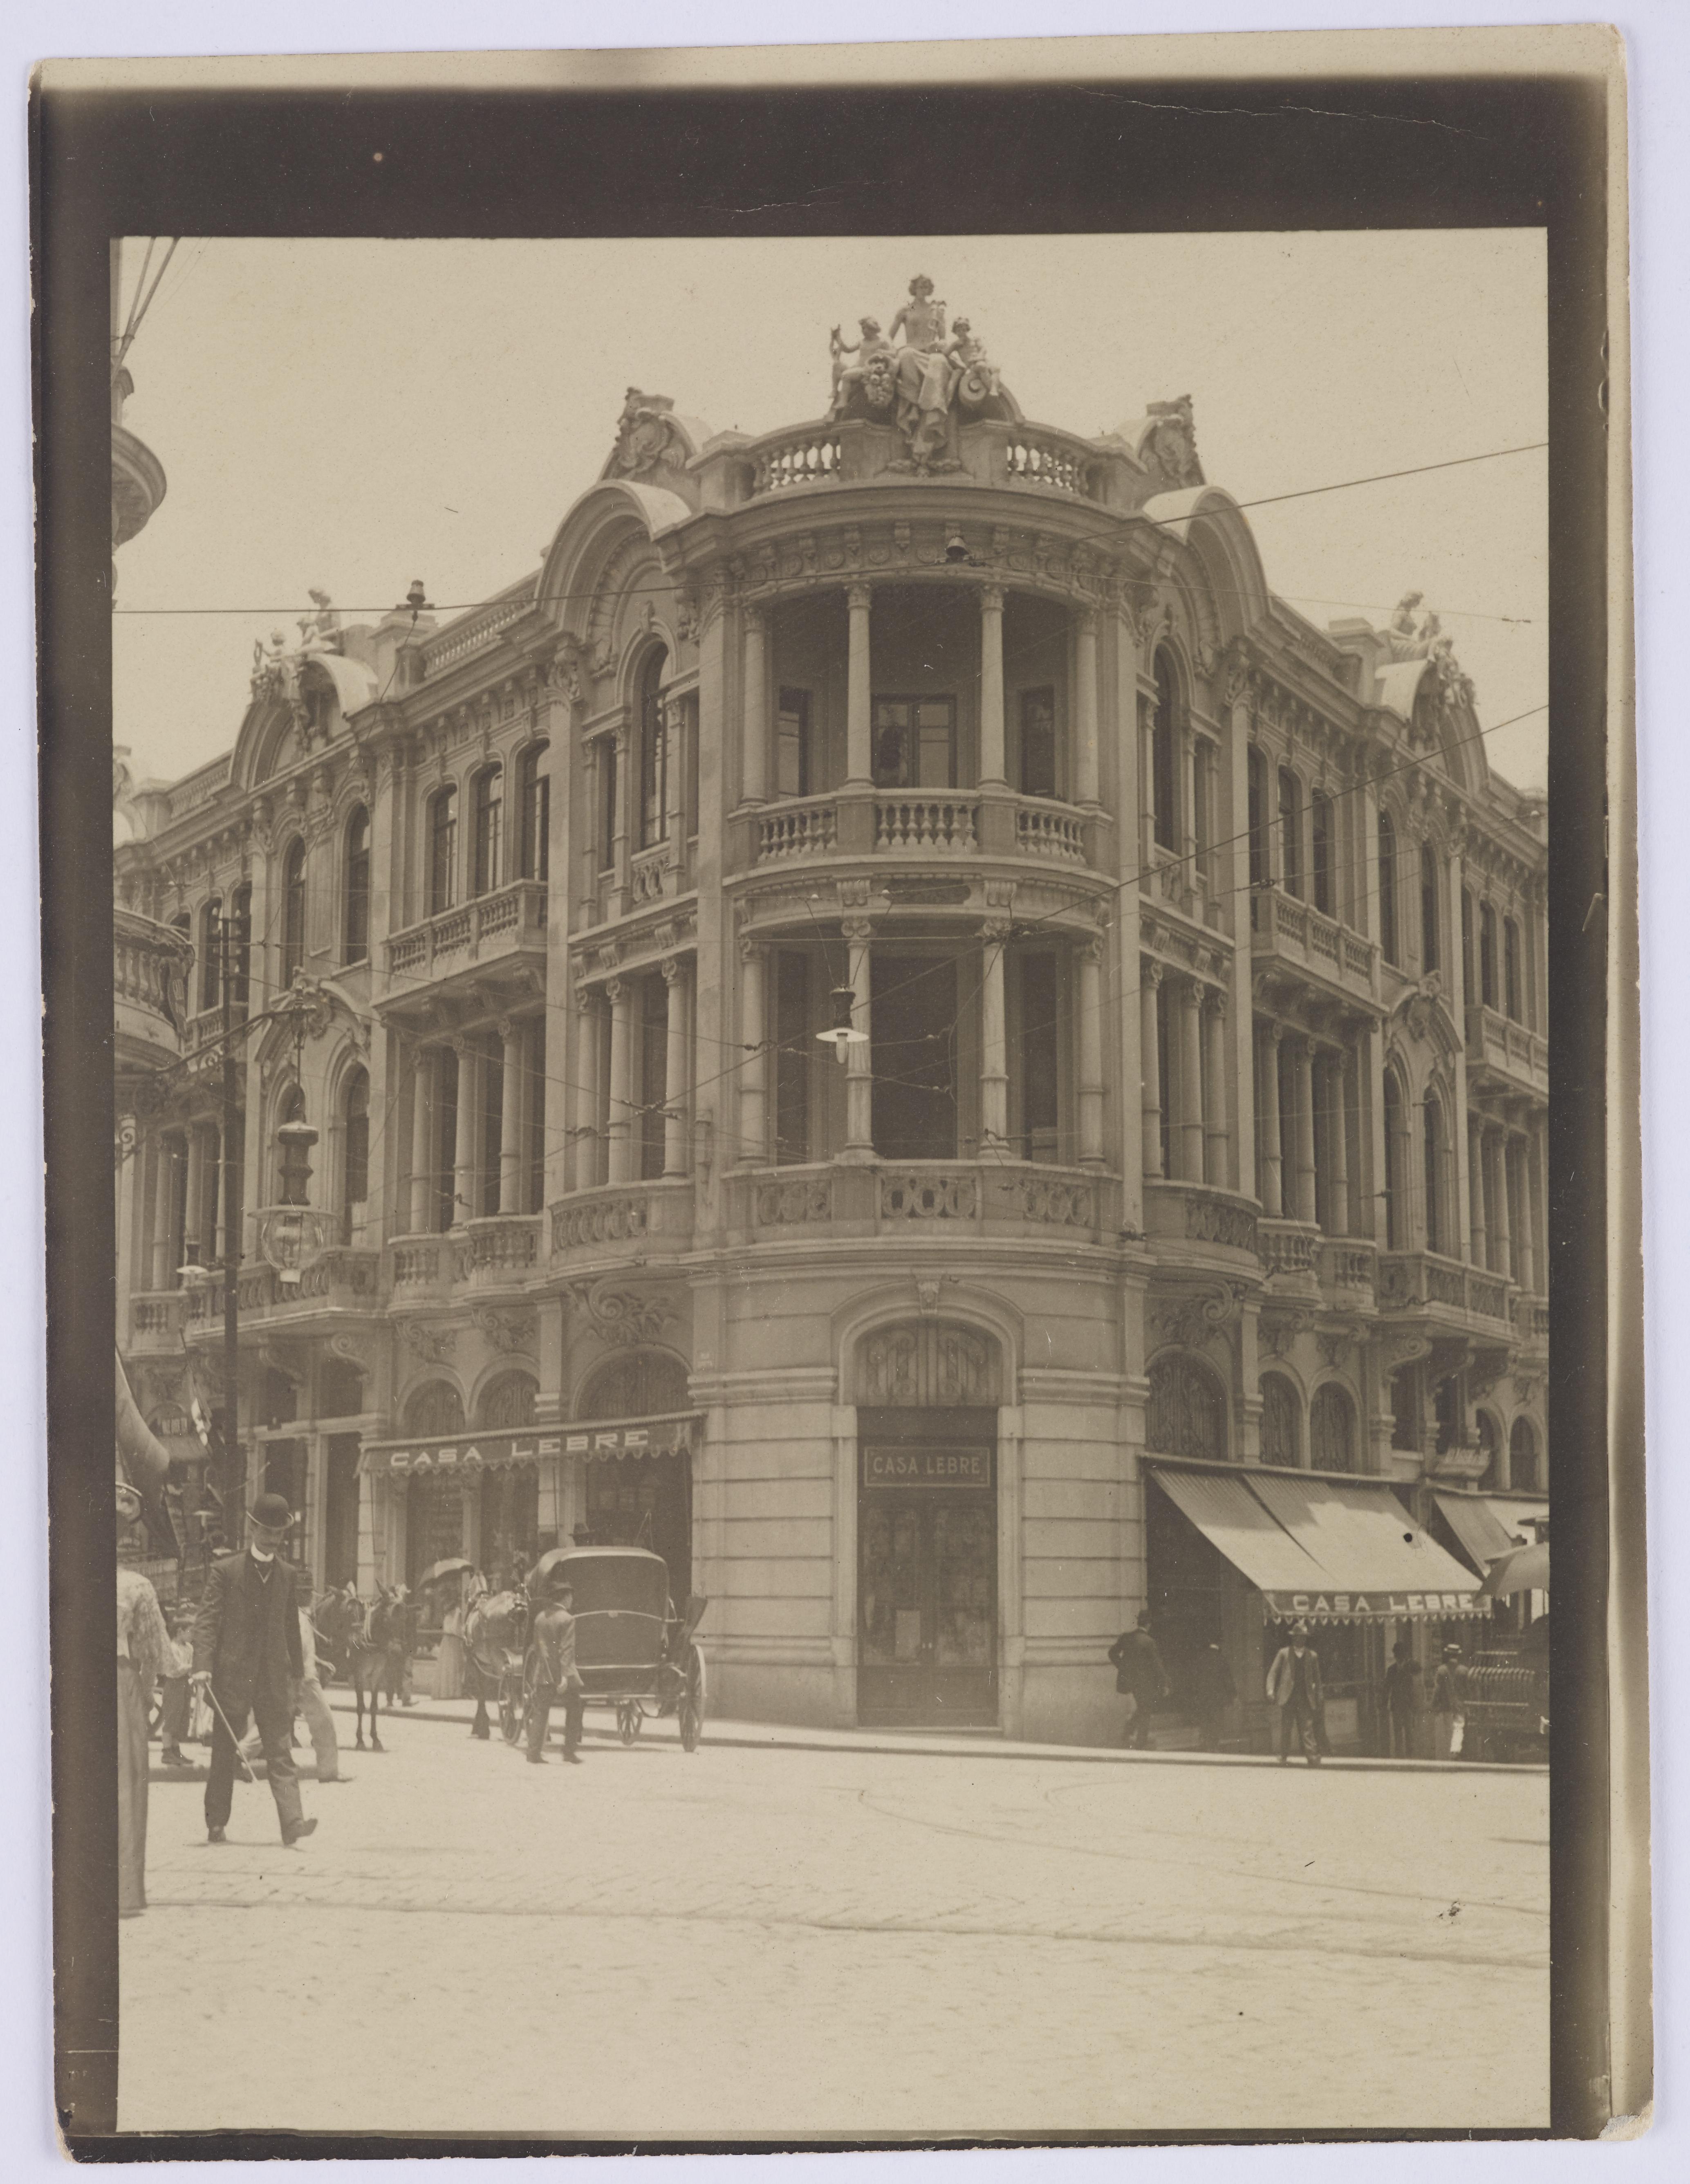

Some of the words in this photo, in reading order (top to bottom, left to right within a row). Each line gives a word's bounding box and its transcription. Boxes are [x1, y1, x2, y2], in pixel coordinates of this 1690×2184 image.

[391, 1446, 482, 1466] CASA
[511, 1430, 648, 1457] LEBRE
[873, 1456, 918, 1474] CASA
[927, 1456, 980, 1474] LEBRE
[1293, 1595, 1371, 1611] CASA
[1390, 1594, 1473, 1610] LEBRE
